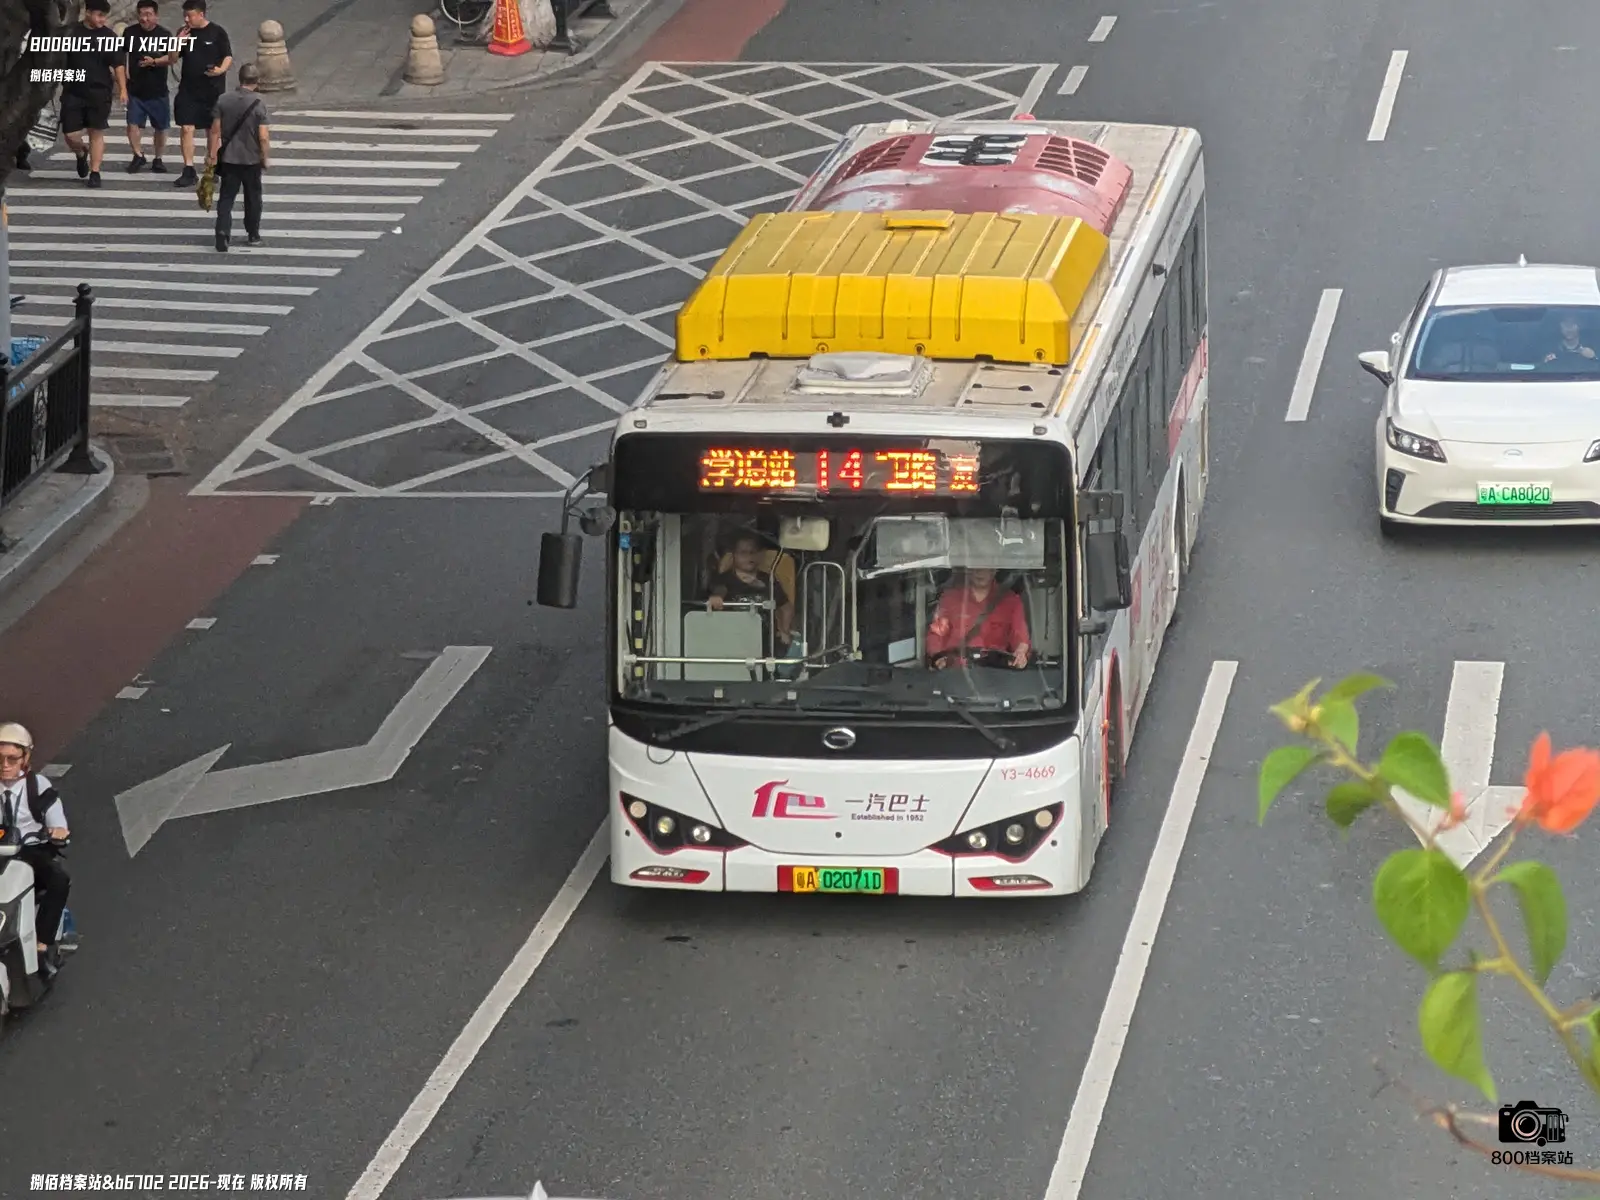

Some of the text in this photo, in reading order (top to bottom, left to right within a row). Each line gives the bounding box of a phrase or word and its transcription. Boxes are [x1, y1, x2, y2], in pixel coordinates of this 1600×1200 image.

[816, 449, 865, 490] 14
[1502, 486, 1550, 501] CA8020
[1001, 765, 1056, 781] Y3-4669
[844, 793, 931, 812] 一汽巴士
[851, 813, 895, 821] Established
[822, 870, 882, 890] 02071D
